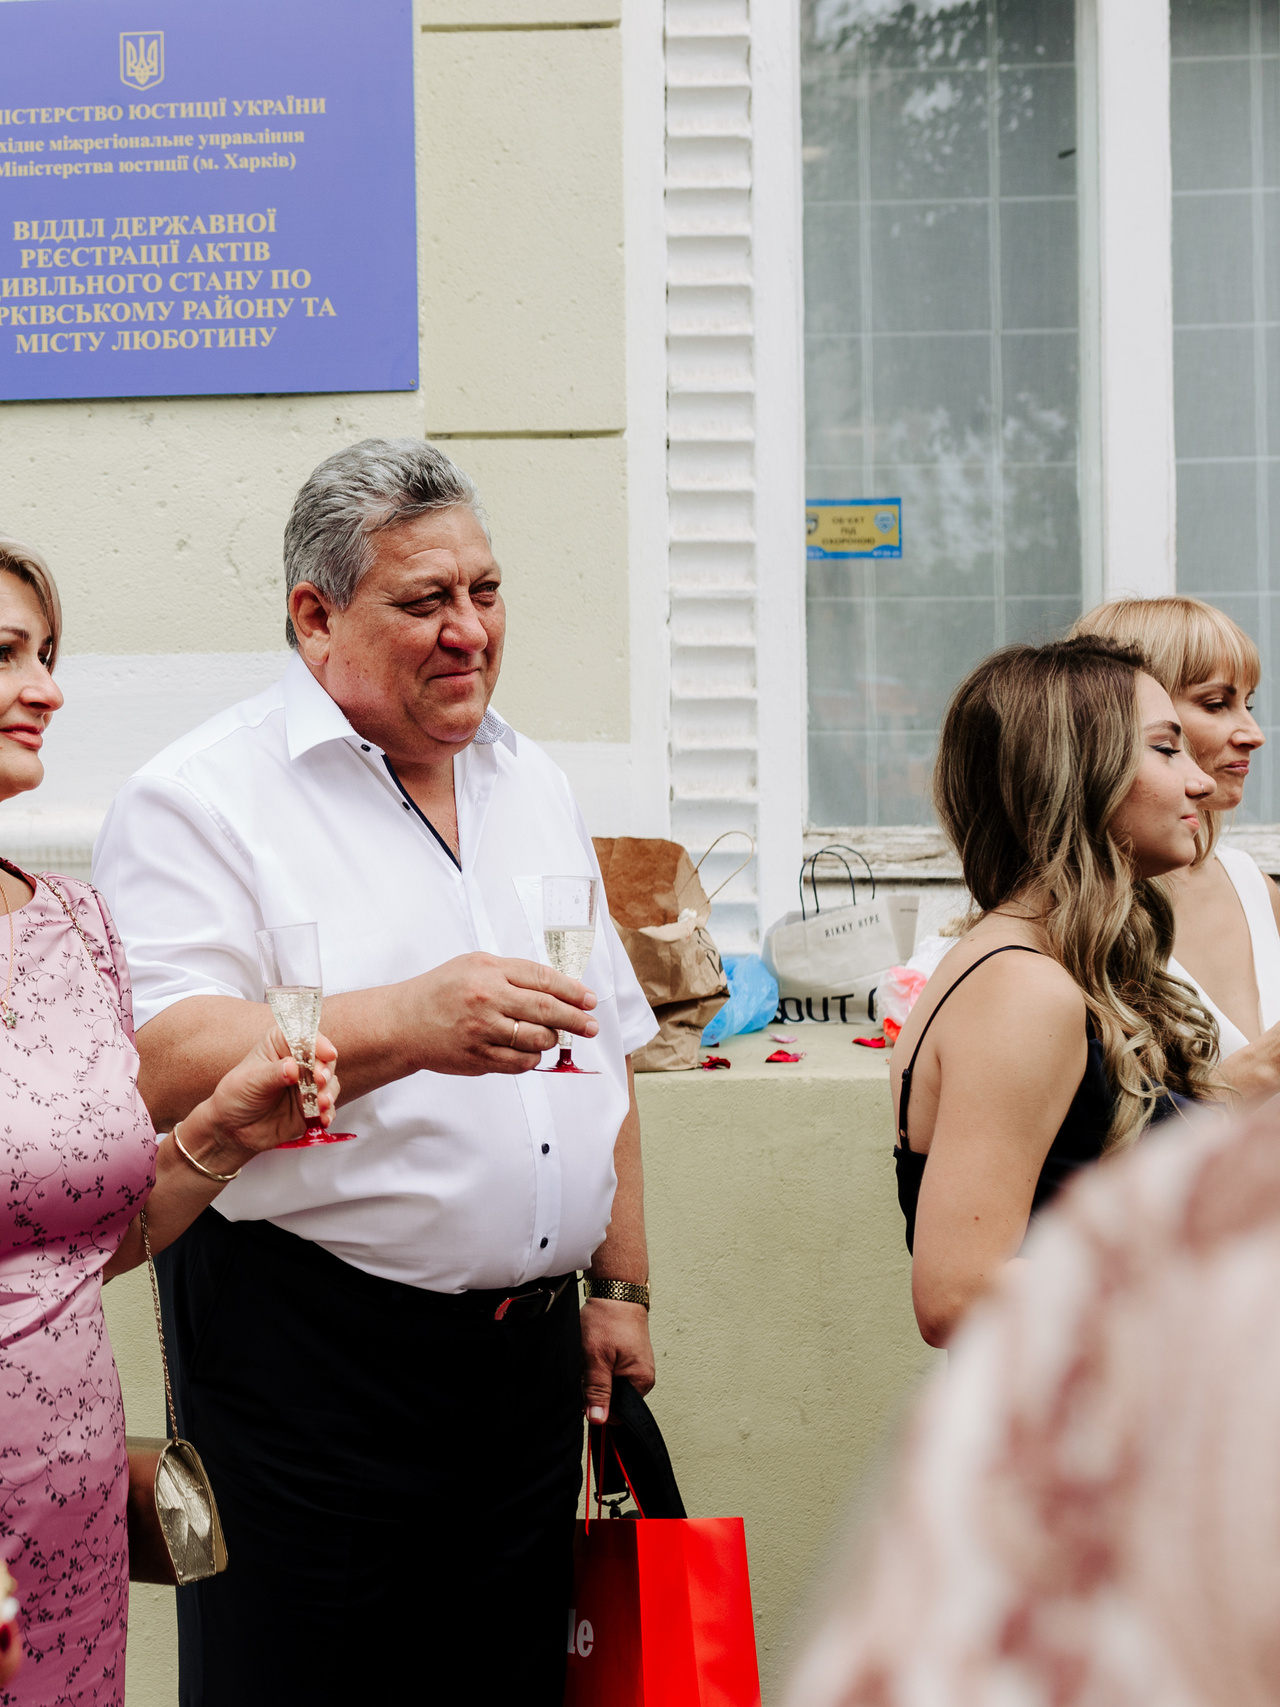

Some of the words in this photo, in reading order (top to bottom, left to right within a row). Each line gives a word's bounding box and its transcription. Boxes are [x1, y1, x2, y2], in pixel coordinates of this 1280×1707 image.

[128, 97, 228, 121] ЮСТИЦІЇ
[231, 95, 327, 118] УКРАЇНИ
[48, 132, 194, 155] міжрегіональне
[198, 128, 305, 150] управління
[118, 154, 189, 174] юстиції
[192, 154, 220, 174] (м.
[224, 151, 297, 173] Харків)
[12, 218, 105, 244] ВІДДІЛ
[111, 208, 278, 241] ДЕРЖАВНОЇ
[20, 239, 181, 269] РЕЄСТРАЦІЇ
[186, 241, 272, 264] АКТІВ
[168, 269, 264, 293] СТАНУ
[270, 268, 312, 290] ПО
[182, 294, 295, 321] РАЙОНУ
[300, 297, 338, 318] ТА
[15, 331, 106, 355] МІСТУ
[111, 327, 278, 352] ЛЮБОТИНУ
[824, 922, 853, 938] RIKKY
[567, 1608, 594, 1658] le
